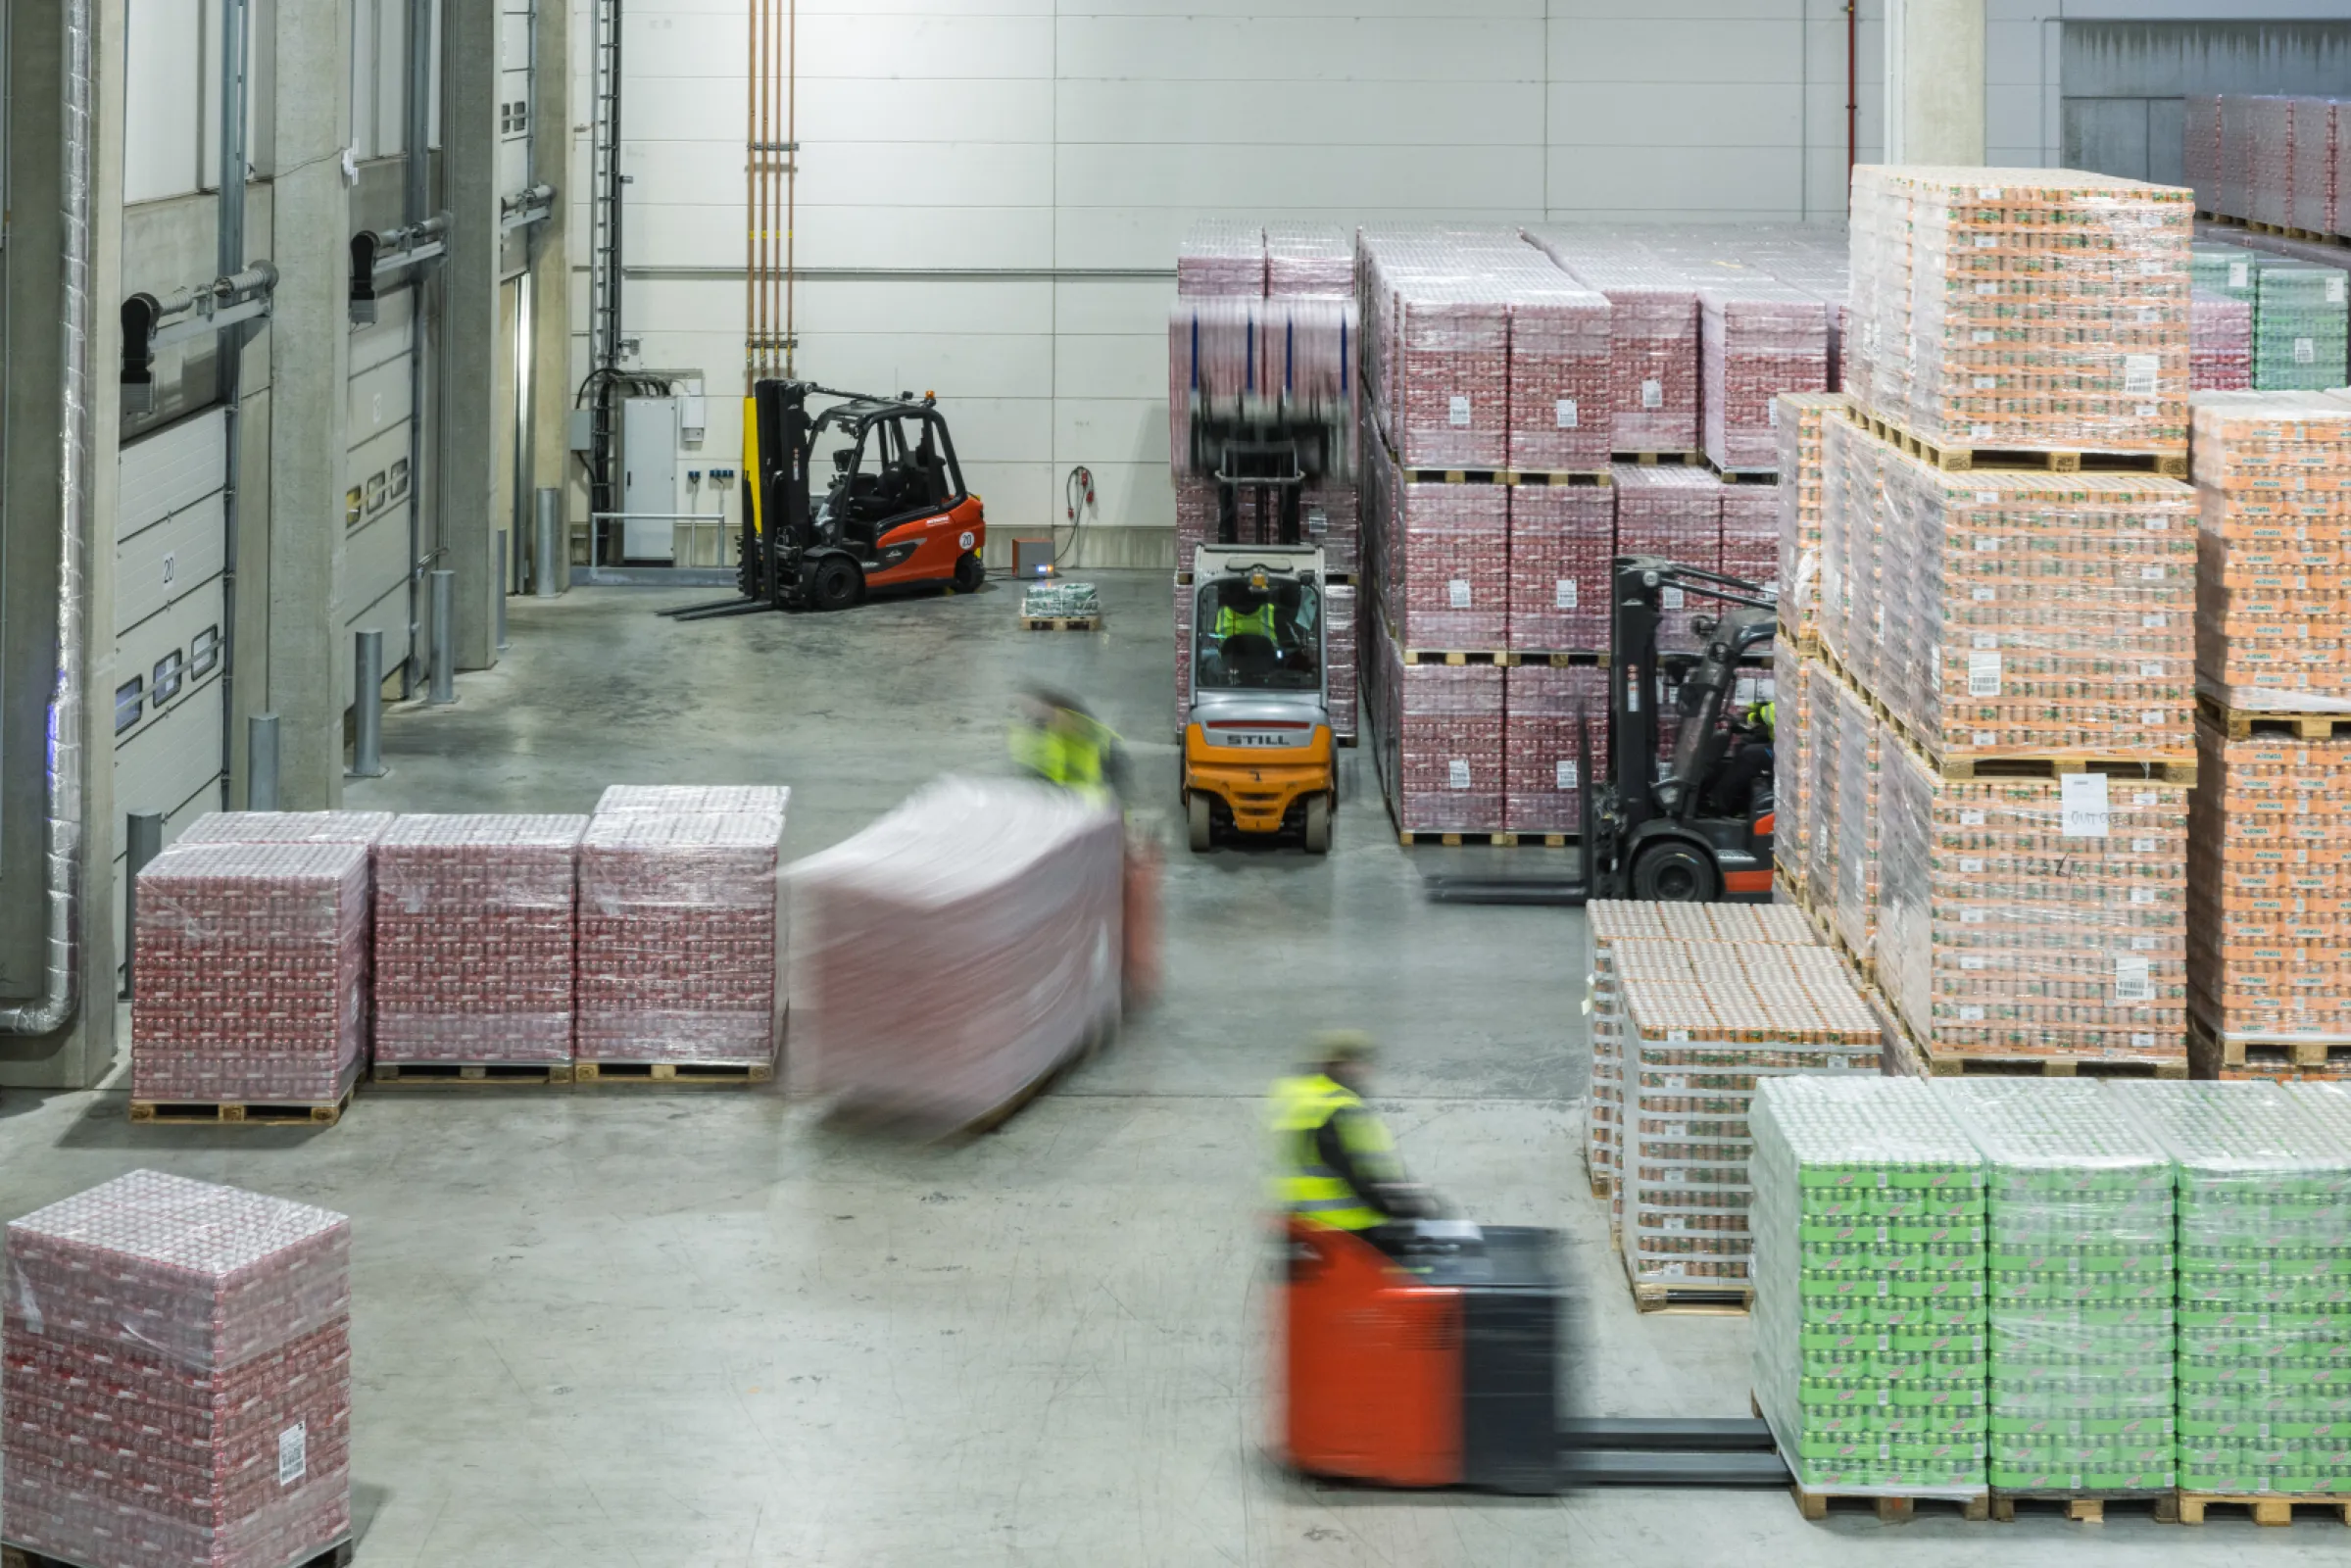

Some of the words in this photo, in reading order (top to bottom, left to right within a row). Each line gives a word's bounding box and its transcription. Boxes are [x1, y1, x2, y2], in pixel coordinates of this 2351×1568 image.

[960, 534, 972, 546] 20
[164, 556, 174, 584] 20
[1227, 735, 1291, 746] STILL
